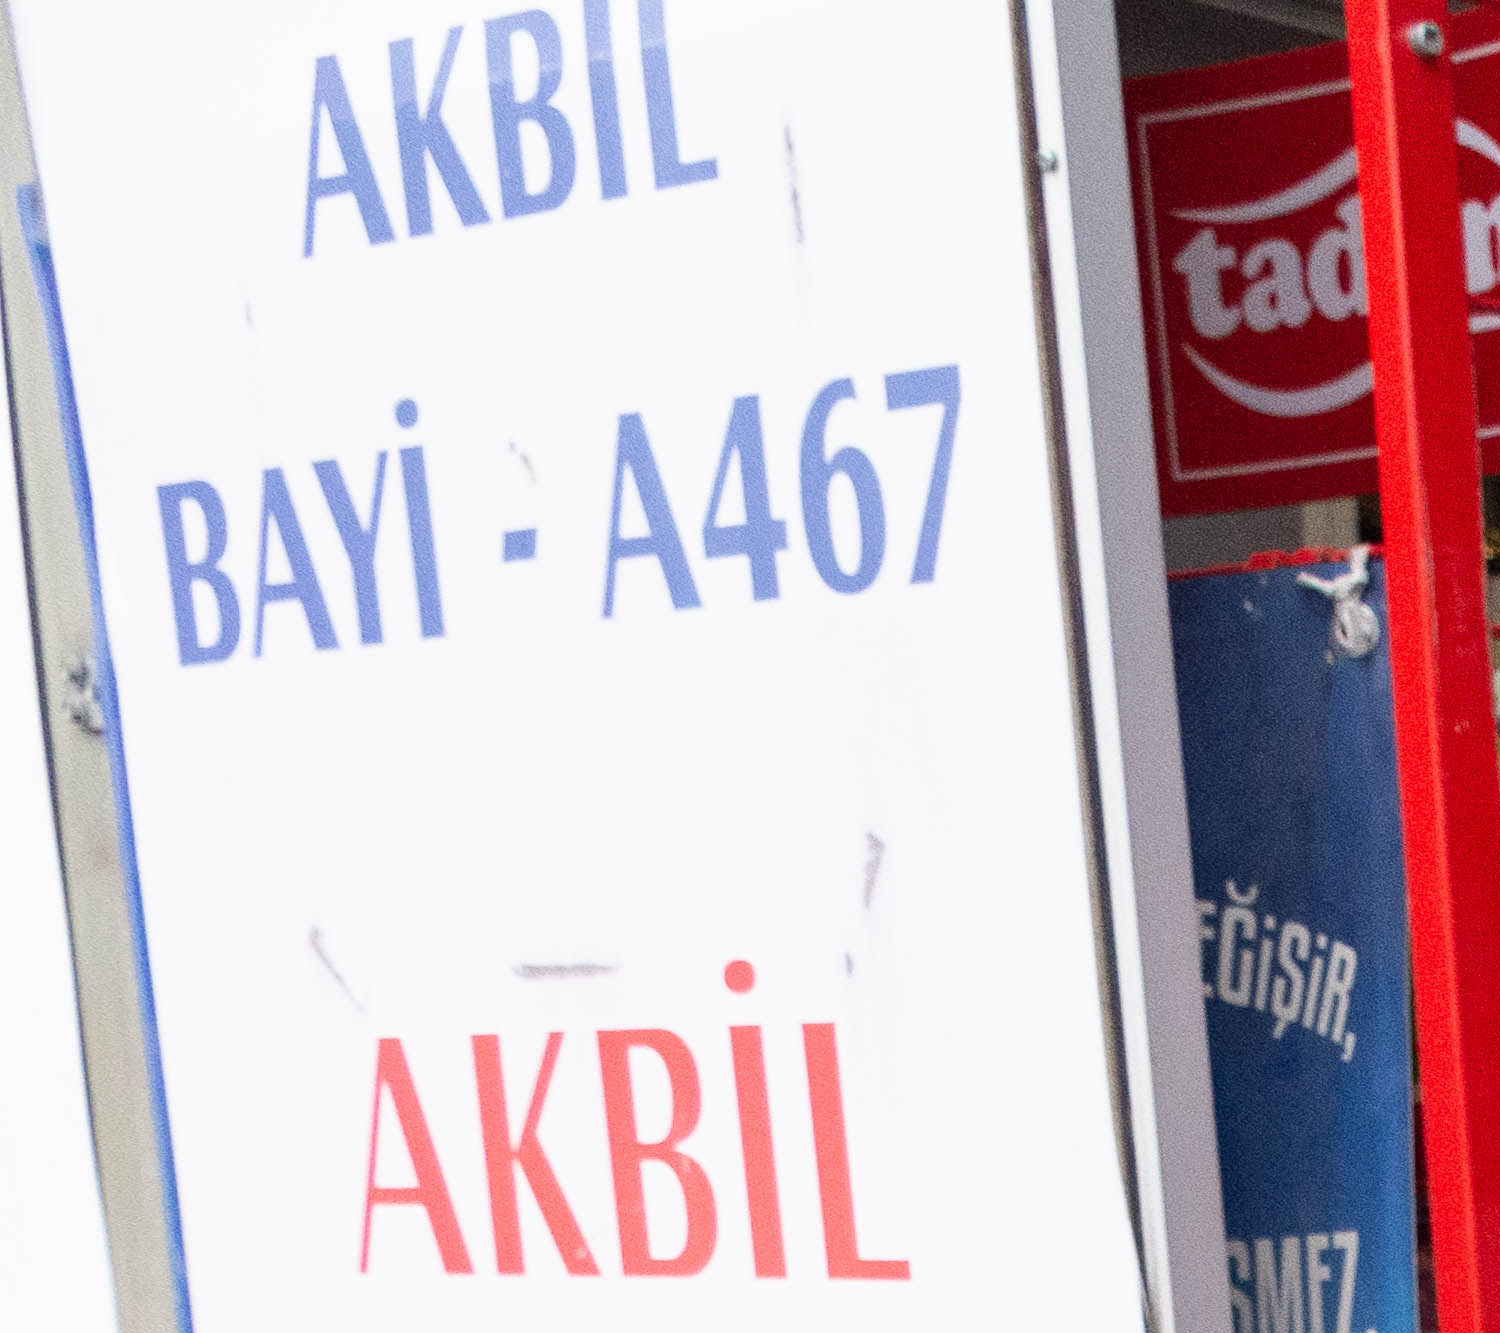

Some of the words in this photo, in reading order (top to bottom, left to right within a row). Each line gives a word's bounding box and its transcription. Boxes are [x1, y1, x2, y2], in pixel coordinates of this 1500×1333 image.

[155, 398, 447, 668] BAYİ
[502, 527, 538, 563] -
[601, 364, 962, 620] A467
[360, 959, 912, 1281] AKBİL
